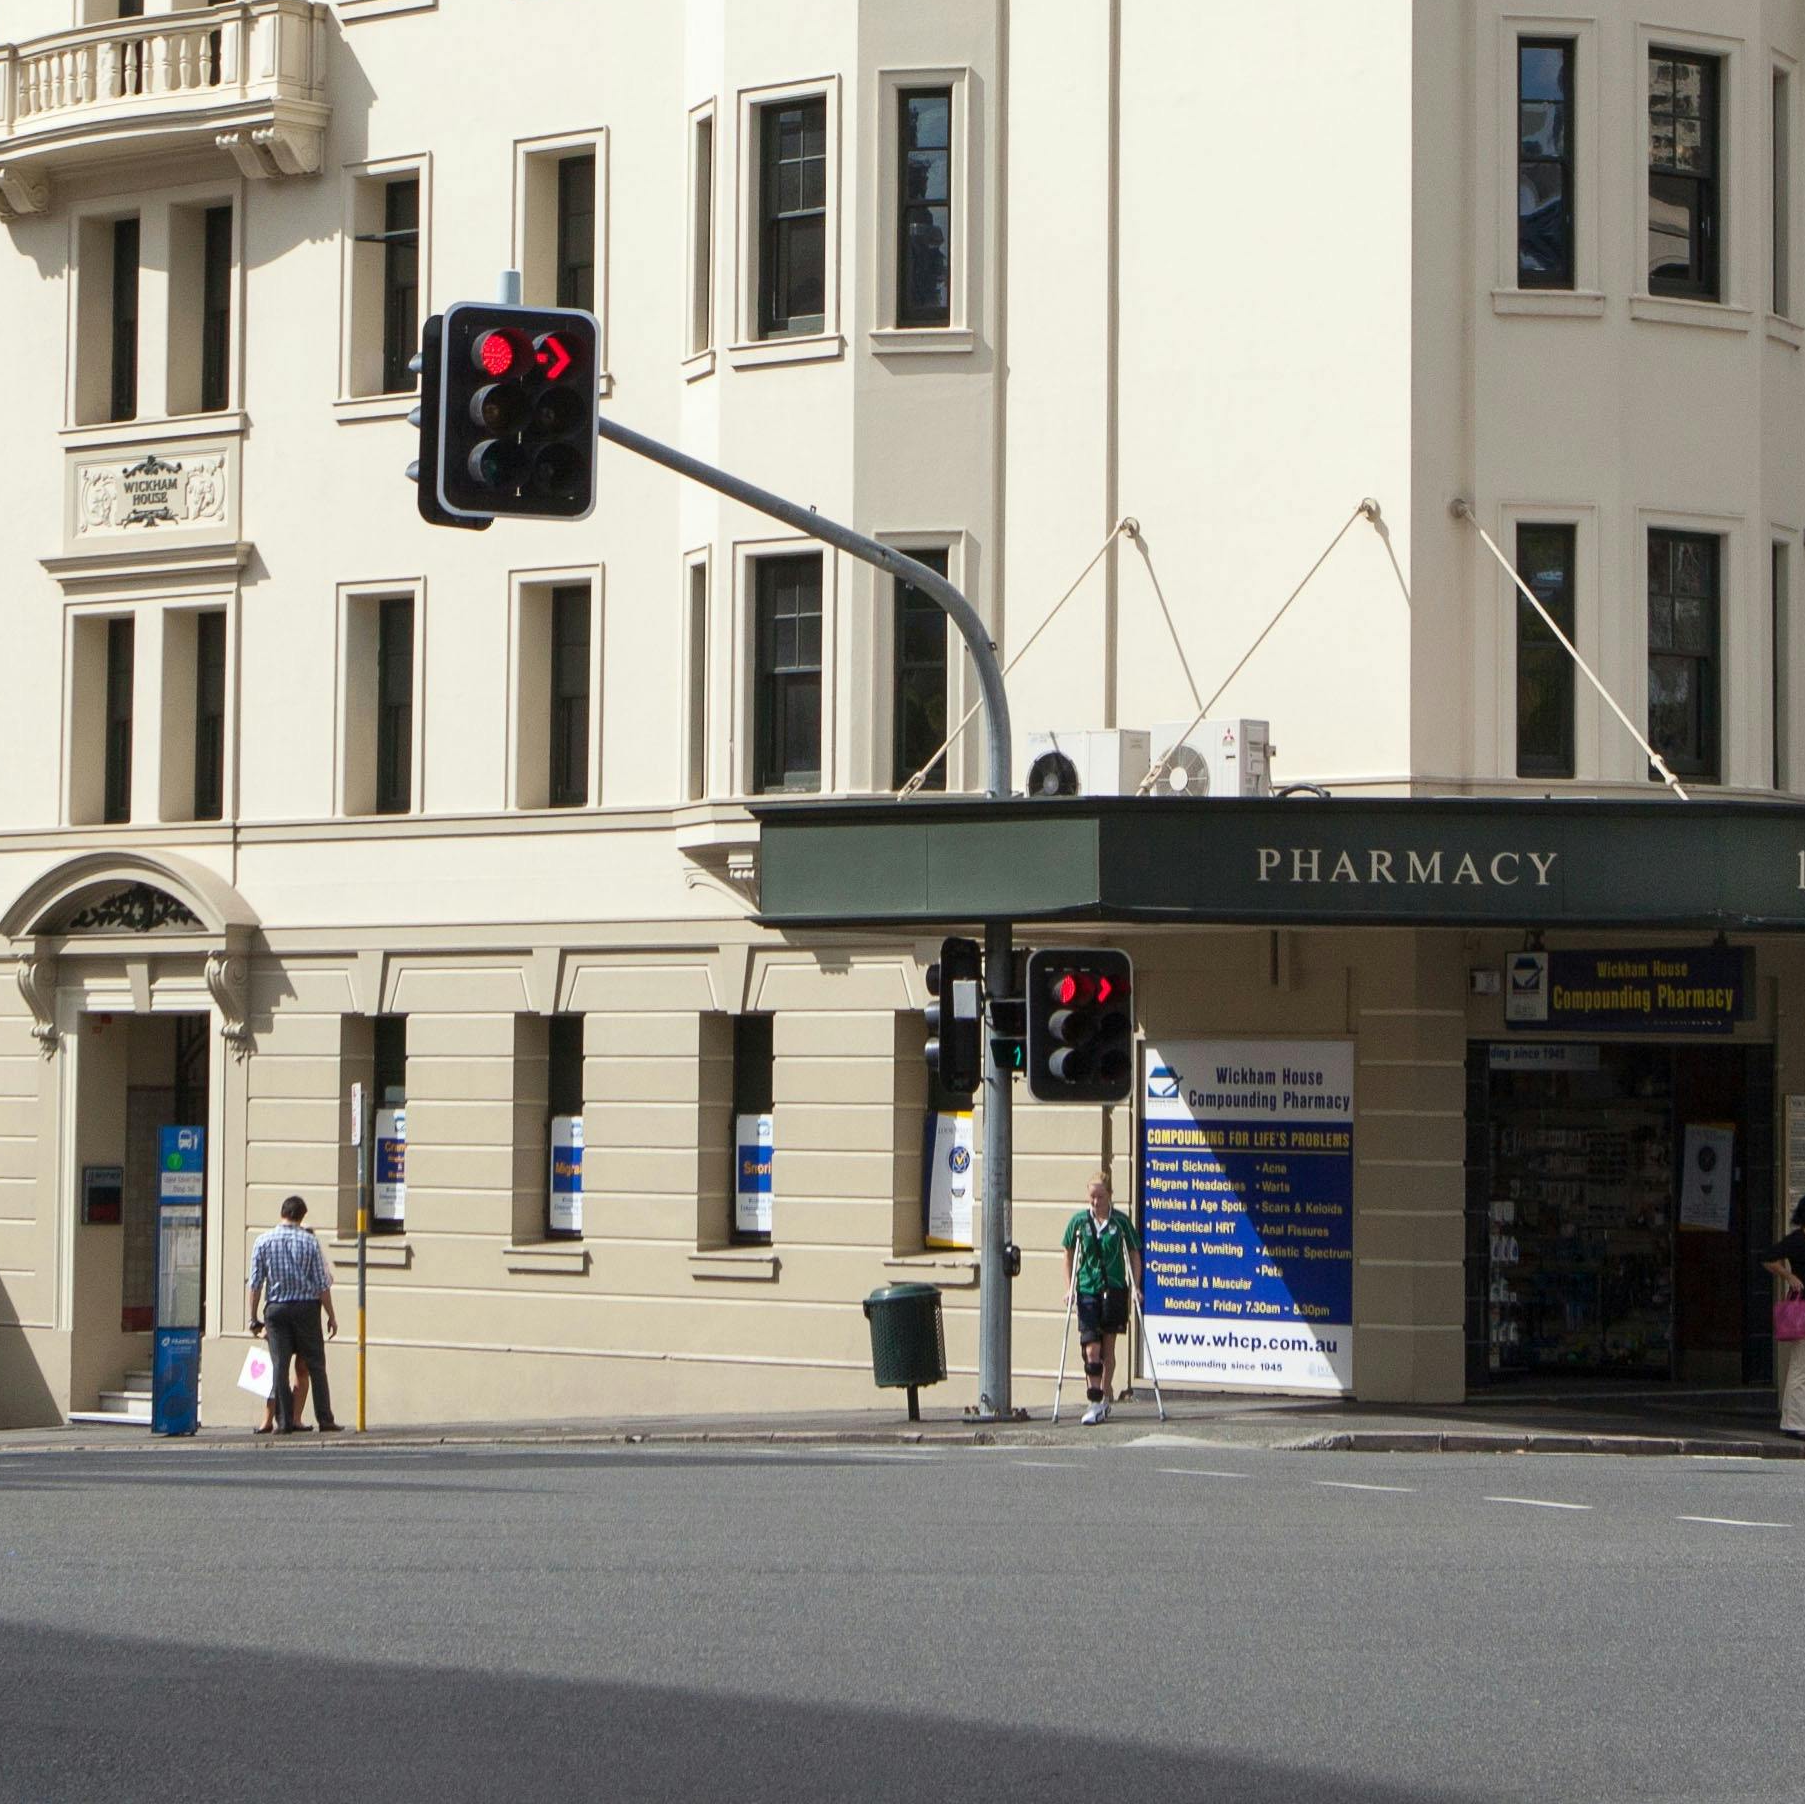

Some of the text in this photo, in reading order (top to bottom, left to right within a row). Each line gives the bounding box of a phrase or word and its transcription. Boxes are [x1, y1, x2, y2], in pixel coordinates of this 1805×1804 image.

[124, 478, 178, 493] WICKHAM
[133, 492, 168, 506] HOUSE
[1256, 847, 1559, 886] PHARMACY
[1597, 960, 1689, 978] Wickham House
[1553, 984, 1734, 1013] Compounding Pharmacy
[1216, 1067, 1323, 1085] Wickham House
[1189, 1090, 1350, 1111] Compounding Pharmacy
[1147, 1129, 1350, 1147] COMPOUNDING FOR LIFE'S PROBLEMS
[1152, 1160, 1226, 1173] Travel Sickness
[1262, 1162, 1287, 1174] Acne
[1150, 1178, 1246, 1192] Migrane Headaches
[1262, 1181, 1290, 1193] Warts
[1151, 1198, 1247, 1213] Wrinkles & Age Spots
[1262, 1202, 1290, 1214] Scars
[1306, 1203, 1343, 1215] Keloids
[1151, 1220, 1236, 1234] Bio-identical HRT
[1262, 1225, 1329, 1237] Anal Fissures
[1150, 1241, 1244, 1257] Nausea & Vomiting
[1262, 1246, 1352, 1261] Autistic Spectrum
[1151, 1261, 1188, 1275] Cramps
[1261, 1265, 1283, 1277] Pets
[1157, 1275, 1252, 1290] Nocturnal & Muscular
[1165, 1298, 1201, 1312] Monday
[1213, 1299, 1242, 1314] Friday
[1246, 1302, 1281, 1315] 7.30am
[1158, 1331, 1338, 1353] www.whcp.com.au
[1231, 1362, 1256, 1371] since
